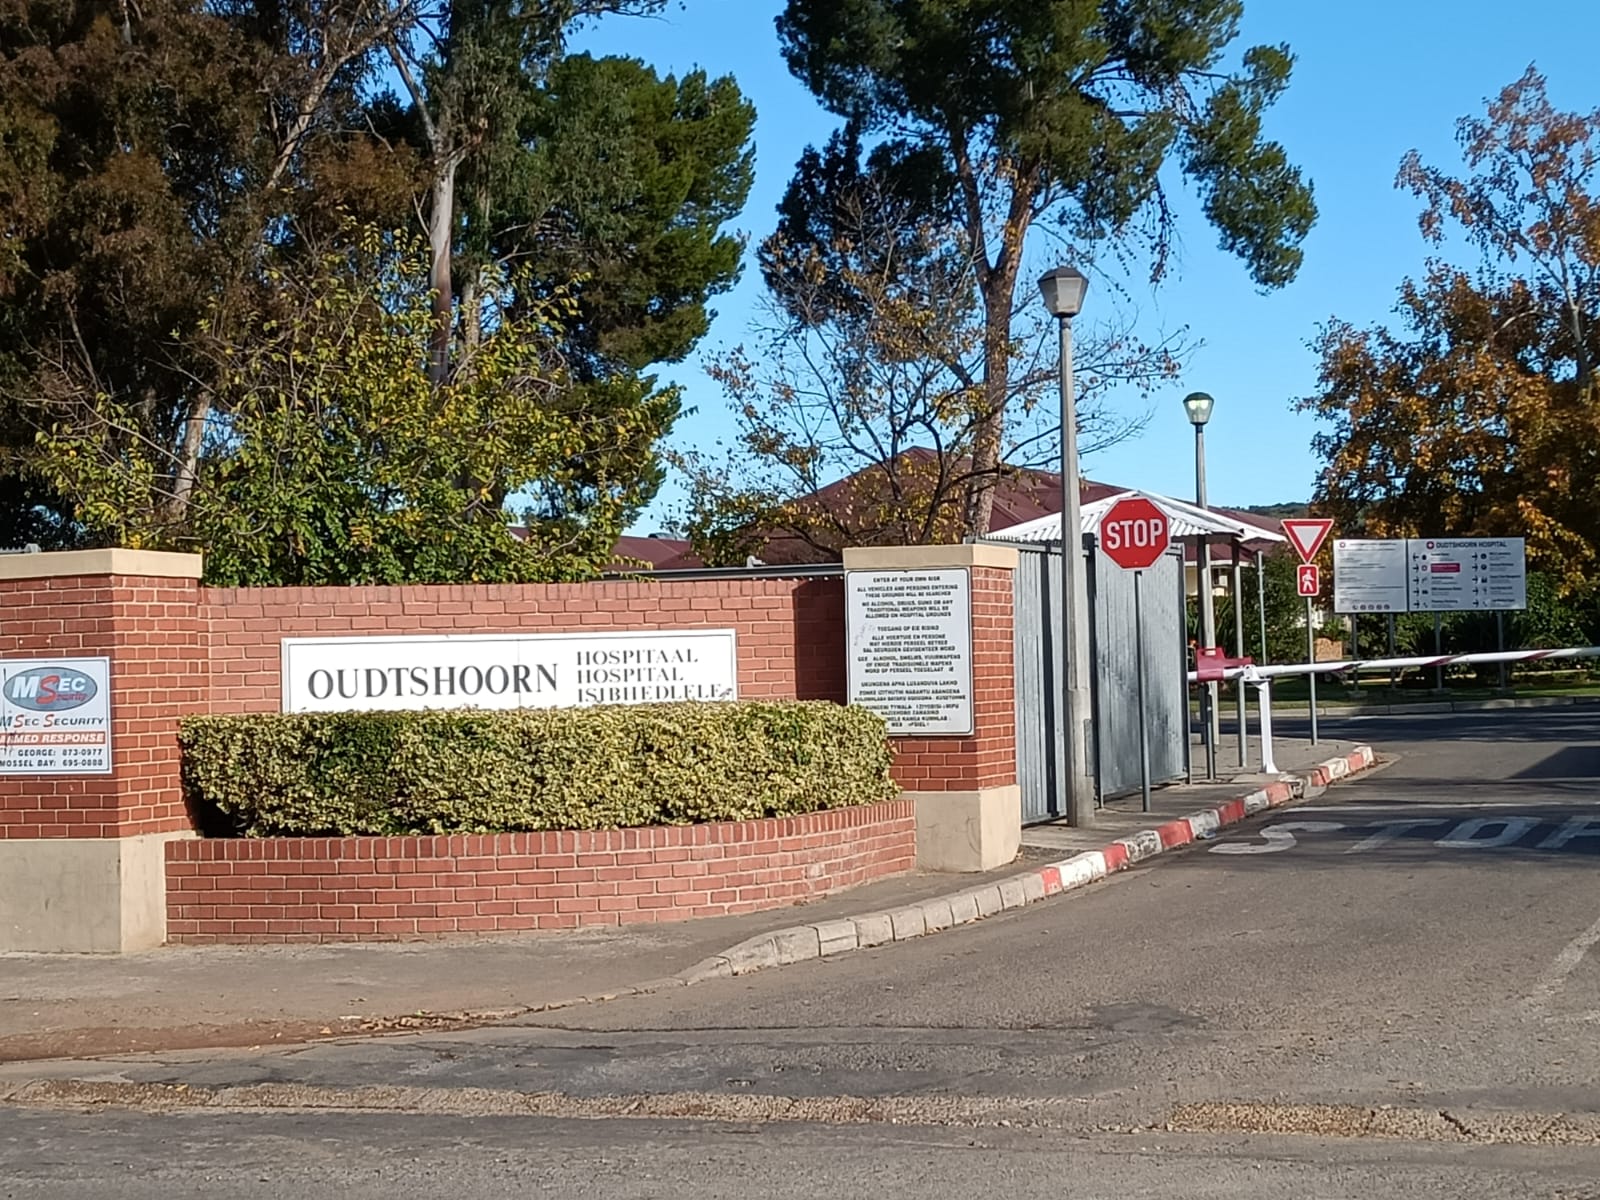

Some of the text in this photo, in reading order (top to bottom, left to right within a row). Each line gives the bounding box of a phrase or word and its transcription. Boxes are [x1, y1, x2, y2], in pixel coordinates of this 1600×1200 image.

[1106, 518, 1164, 549] STOP
[577, 649, 698, 666] HOSPITAAL
[308, 664, 558, 699] OUDTSHOORN
[577, 667, 684, 684] HOSPITAL
[42, 733, 105, 743] RESPONSE
